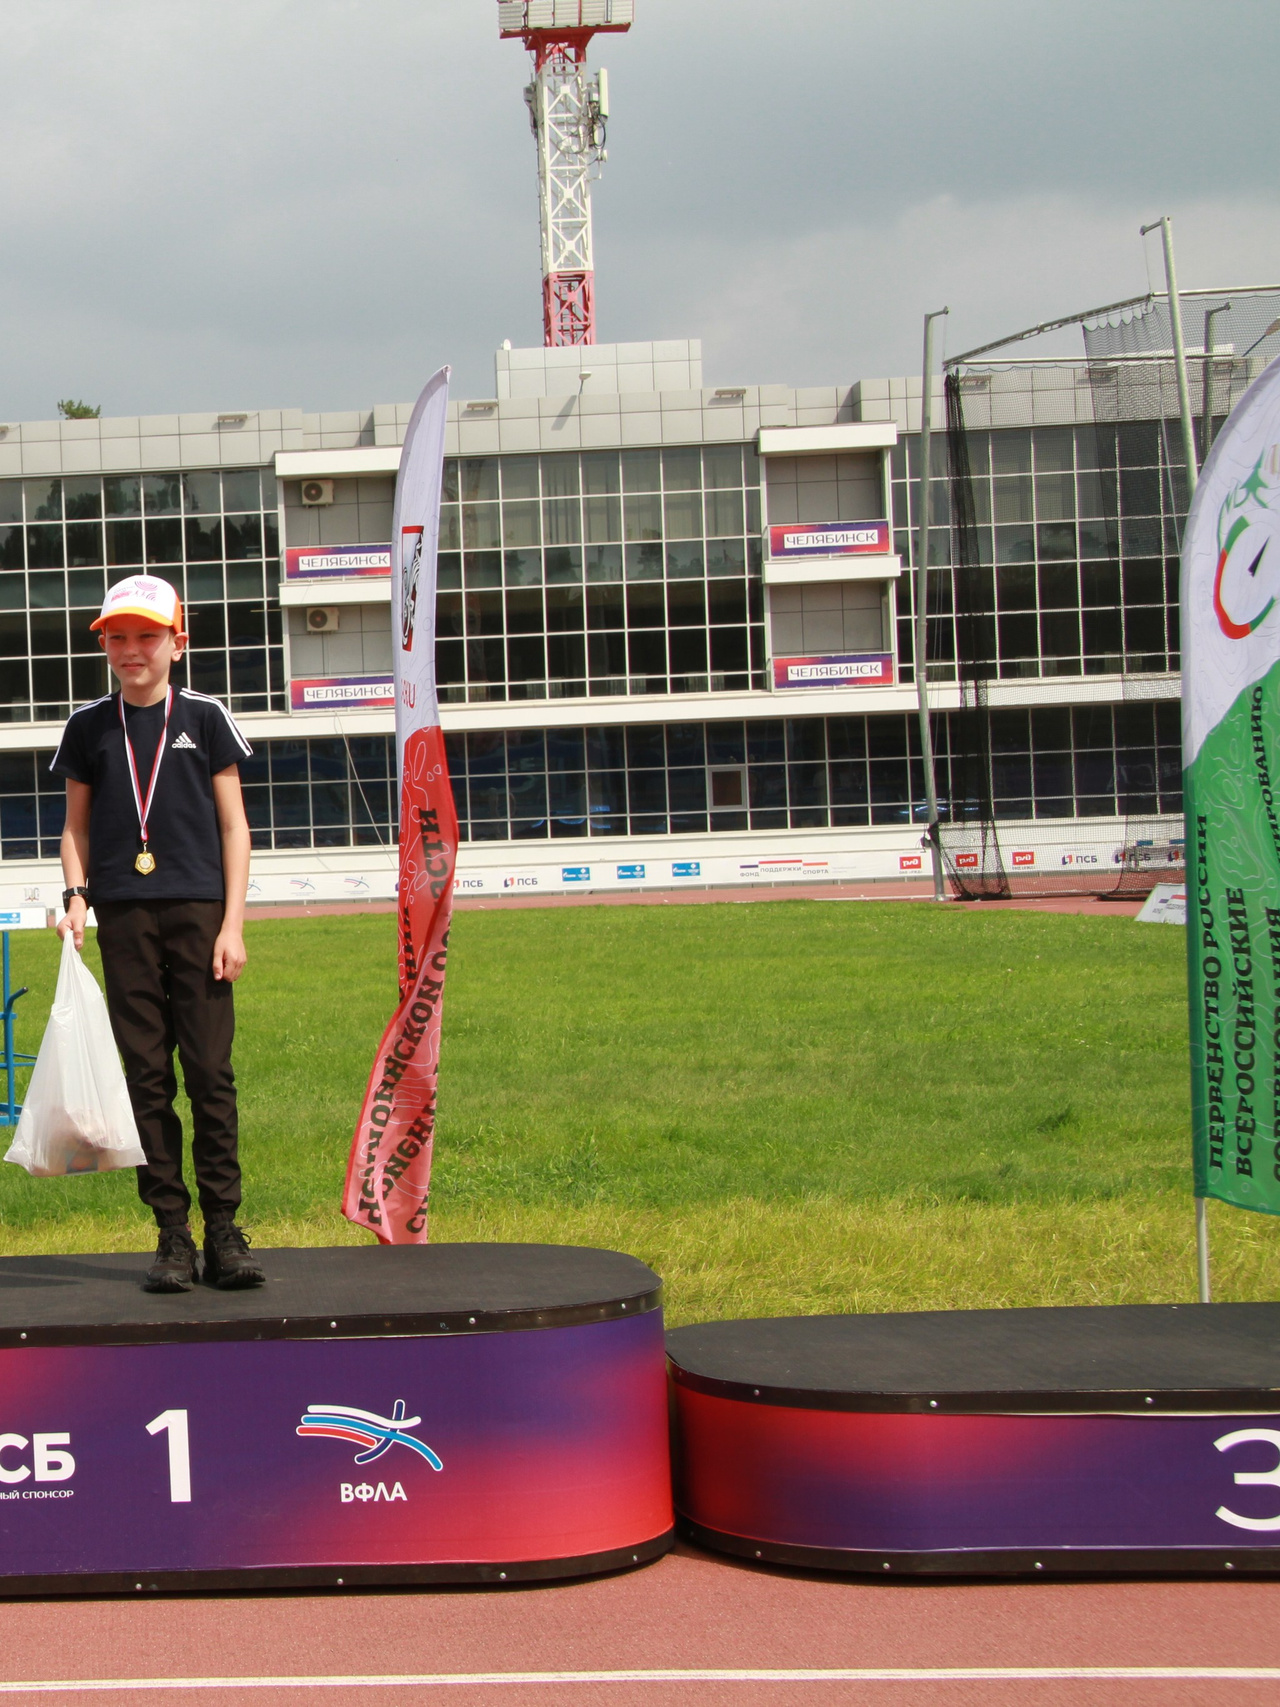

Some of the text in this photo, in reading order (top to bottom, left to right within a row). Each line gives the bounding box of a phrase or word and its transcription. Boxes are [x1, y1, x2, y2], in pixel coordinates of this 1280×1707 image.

[786, 532, 876, 546] ЧЕЛЯБИНСК
[301, 555, 387, 568] ЧЕЛЯБИНСК
[790, 664, 879, 678] ЧЕЛЯБИНСК
[306, 685, 392, 699] ЧЕЛЯБИНСК
[1076, 855, 1098, 863] ПСБ
[463, 880, 483, 888] ПСБ
[517, 878, 538, 886] ПСБ
[1197, 814, 1226, 1170] ПЕРВЕНСТВО РОССИИ
[1225, 888, 1256, 1178] ВСЕРОССИЙСКИЕ
[145, 1409, 191, 1502] 1
[1213, 1428, 1280, 1531] 3
[22, 1490, 74, 1500] СПОНСОР
[340, 1482, 408, 1503] ВФЛА
